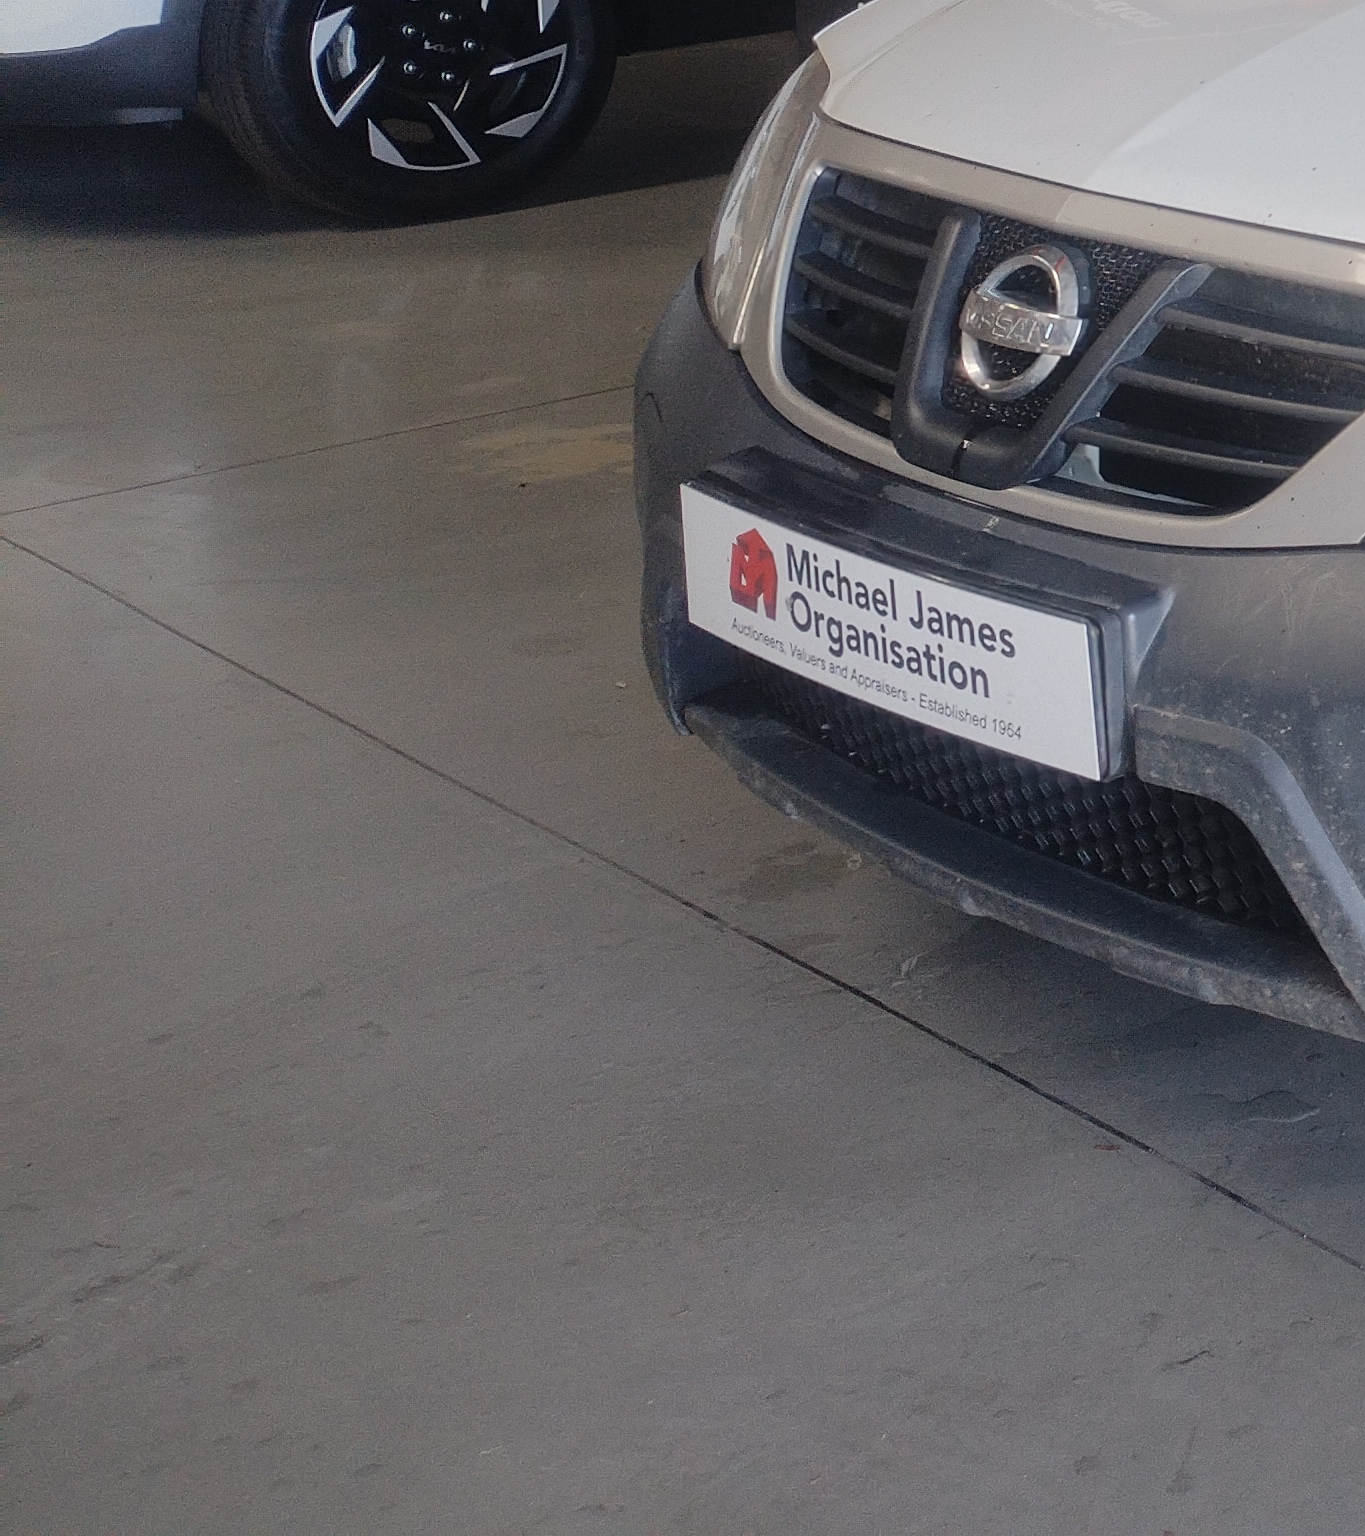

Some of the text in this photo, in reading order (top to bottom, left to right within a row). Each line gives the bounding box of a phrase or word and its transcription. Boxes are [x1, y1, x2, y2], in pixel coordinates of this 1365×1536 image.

[786, 542, 1016, 658] Michael James
[790, 590, 990, 698] Organisation
[731, 617, 787, 657] Auctioneers,
[789, 641, 827, 668] Valuers
[829, 659, 848, 679] and
[850, 668, 908, 704] Appraisers
[919, 693, 988, 730] Established
[991, 718, 1022, 740] 1964
